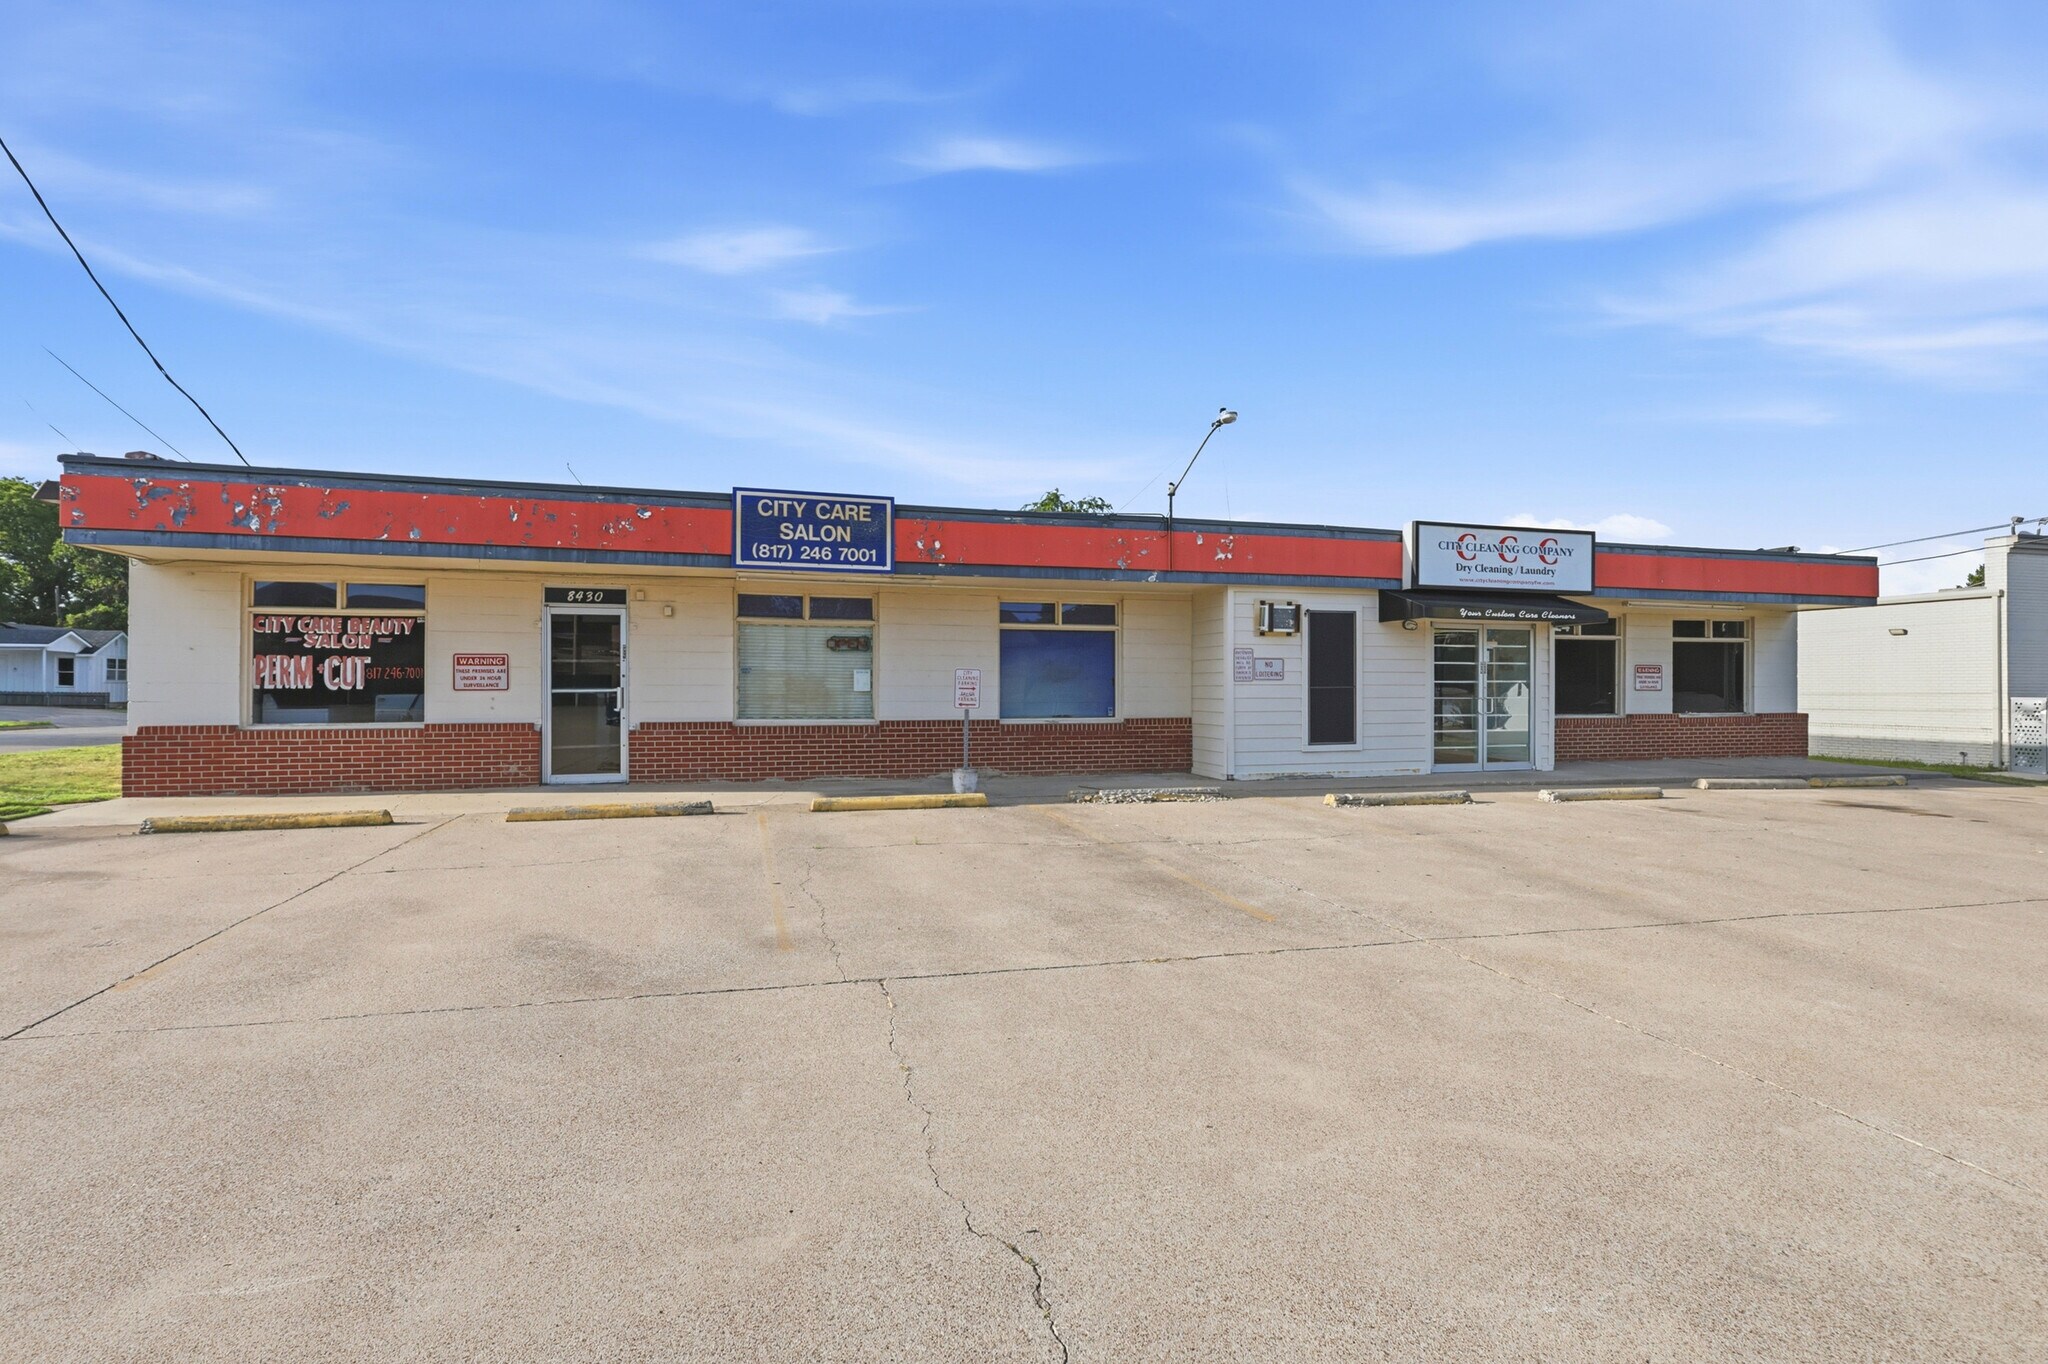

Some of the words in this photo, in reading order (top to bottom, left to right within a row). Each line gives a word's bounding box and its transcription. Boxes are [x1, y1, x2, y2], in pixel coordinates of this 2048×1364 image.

[757, 499, 807, 518] CITY
[815, 503, 872, 522] CARE
[779, 522, 851, 542] SALON
[752, 543, 793, 560] (817)
[800, 546, 832, 560] 246
[838, 547, 877, 562] 7001
[1438, 540, 1465, 551] CITY
[1465, 542, 1520, 554] CLEANING
[1522, 545, 1575, 557] COMPANY
[1456, 562, 1472, 574] Dry
[1475, 564, 1513, 576] Cleaning
[1520, 566, 1556, 577] Laundry
[567, 590, 603, 602] 8430
[1460, 608, 1482, 618] Your
[1485, 609, 1516, 618] Custom
[1518, 610, 1539, 619] Care
[1541, 611, 1576, 619] Cleaners
[253, 616, 297, 634] CITY
[298, 616, 343, 635] CARE
[347, 617, 416, 635] BEAUTY
[303, 633, 372, 649] SALON
[459, 657, 503, 665] WARNING
[253, 655, 314, 690] PERM
[324, 655, 372, 691] CUT
[366, 667, 381, 680] 817
